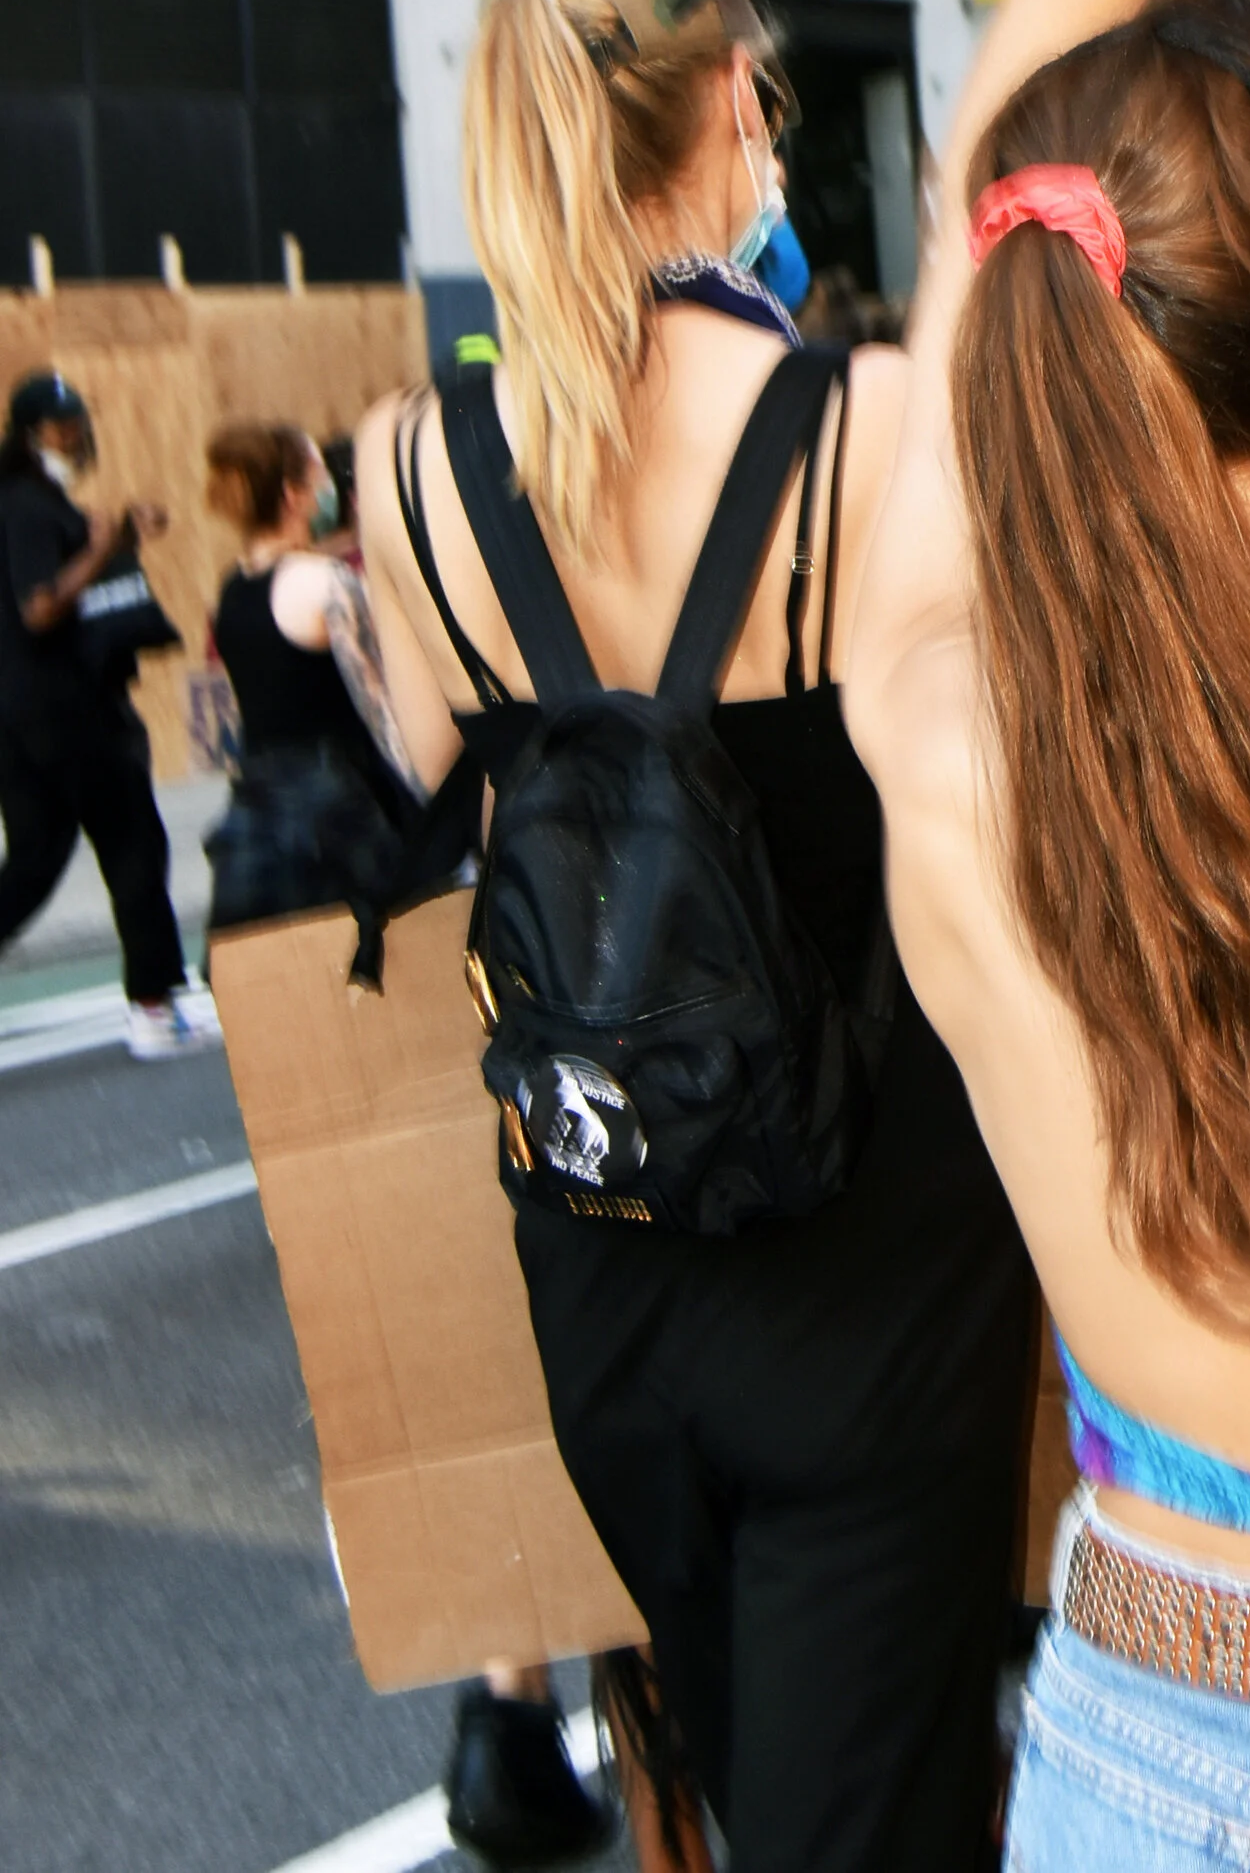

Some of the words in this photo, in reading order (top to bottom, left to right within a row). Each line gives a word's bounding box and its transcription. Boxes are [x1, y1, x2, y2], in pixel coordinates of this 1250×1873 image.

[580, 1084, 627, 1110] JUSTICE
[550, 1156, 568, 1171] NO
[569, 1164, 606, 1187] PEACE
